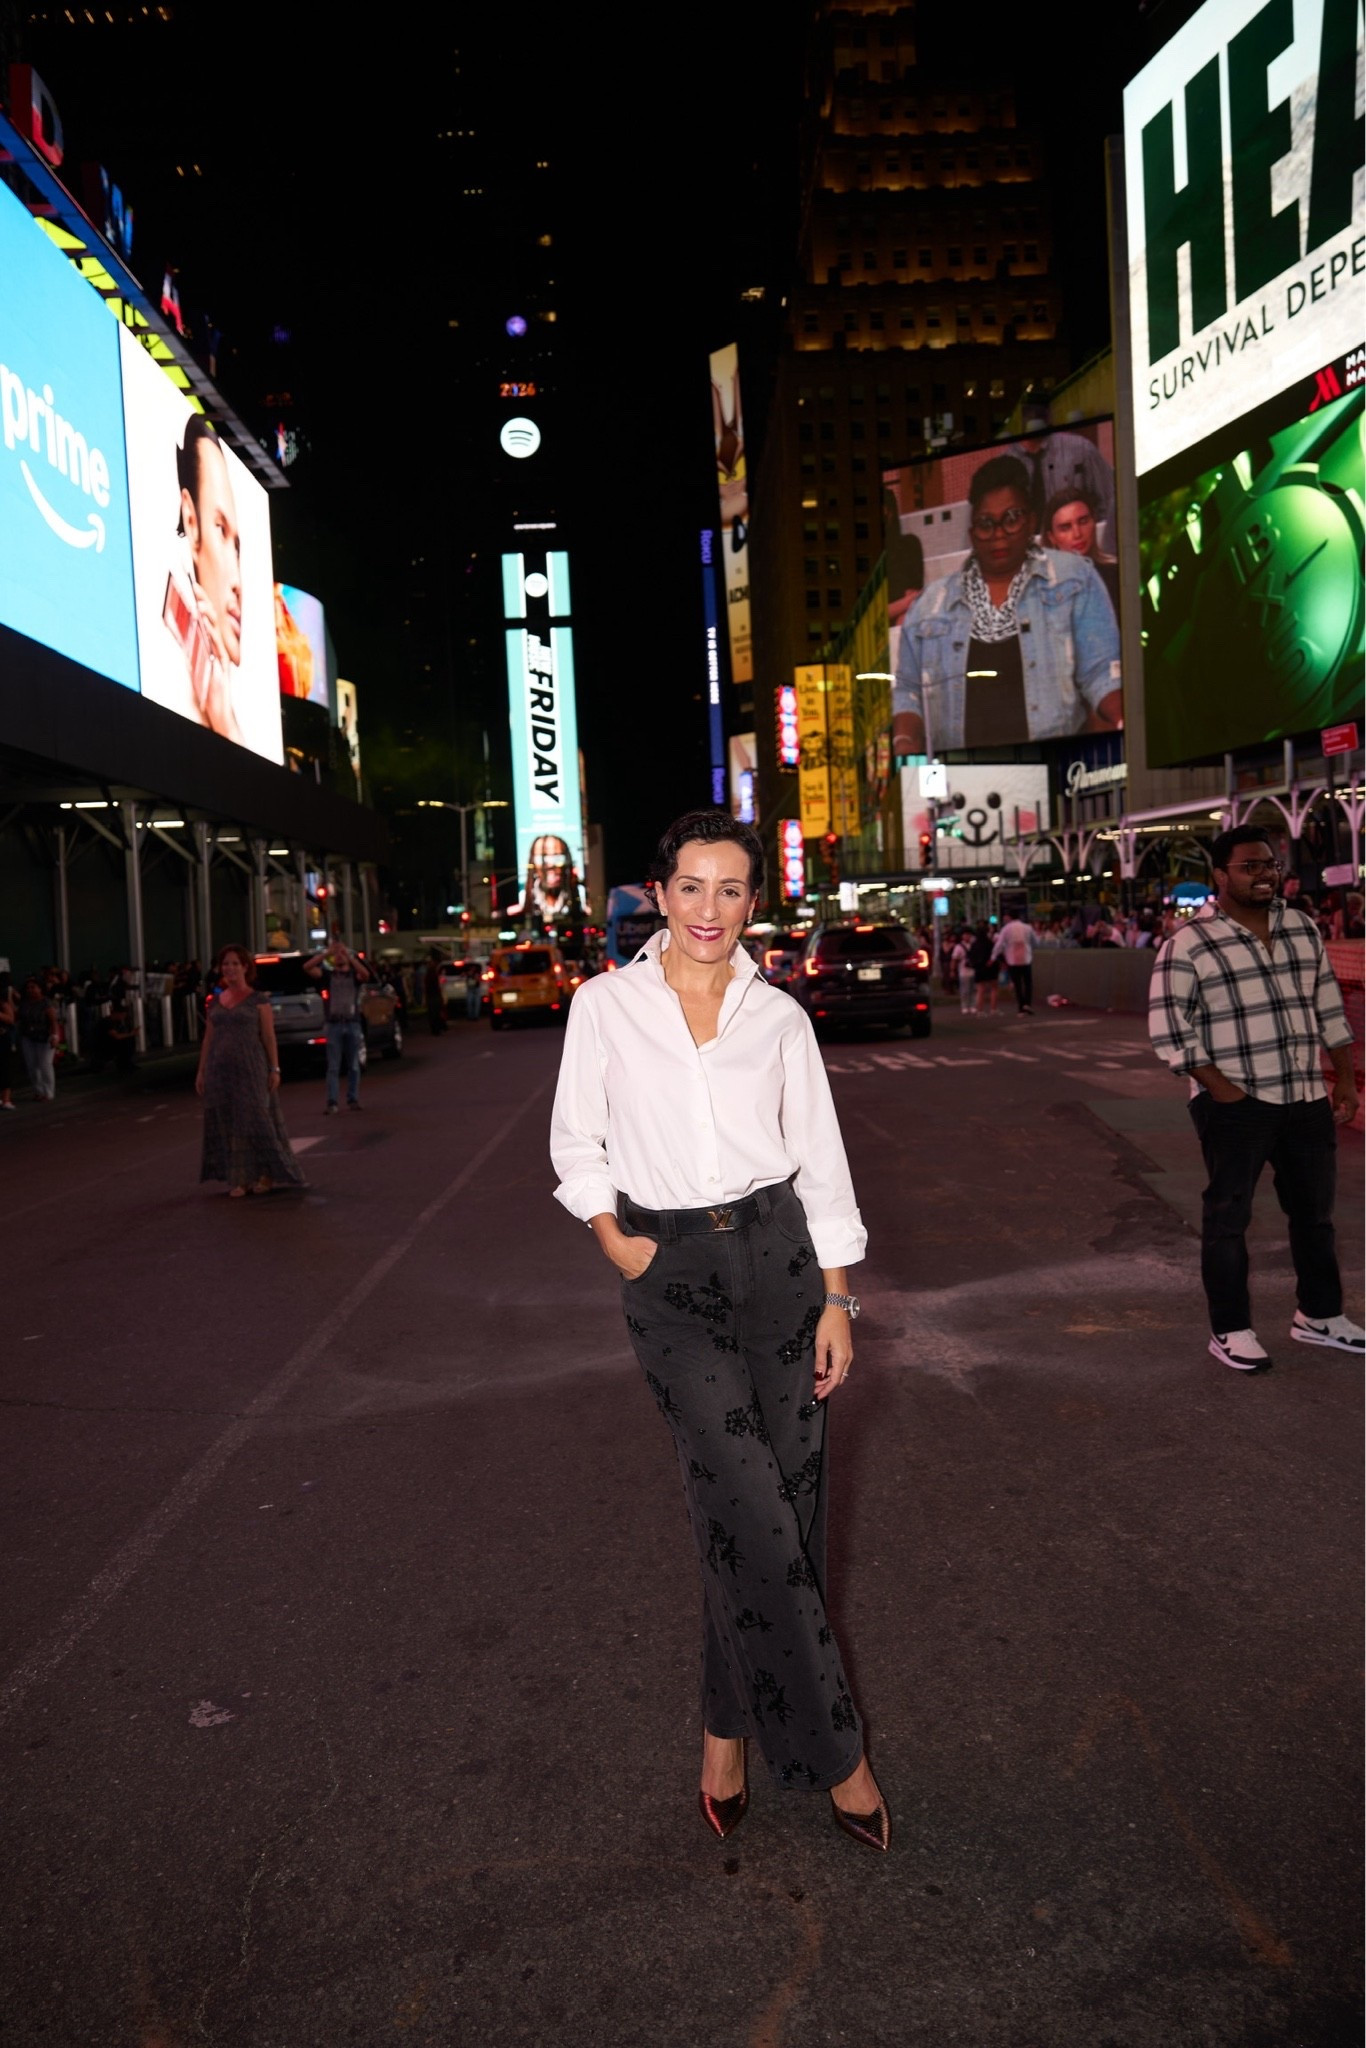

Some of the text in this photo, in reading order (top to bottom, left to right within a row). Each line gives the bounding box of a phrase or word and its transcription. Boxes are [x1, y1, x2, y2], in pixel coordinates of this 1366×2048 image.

[1149, 235, 1365, 411] SURVIVAL DEPE
[0, 363, 110, 508] prime
[528, 667, 560, 804] FRIDAY
